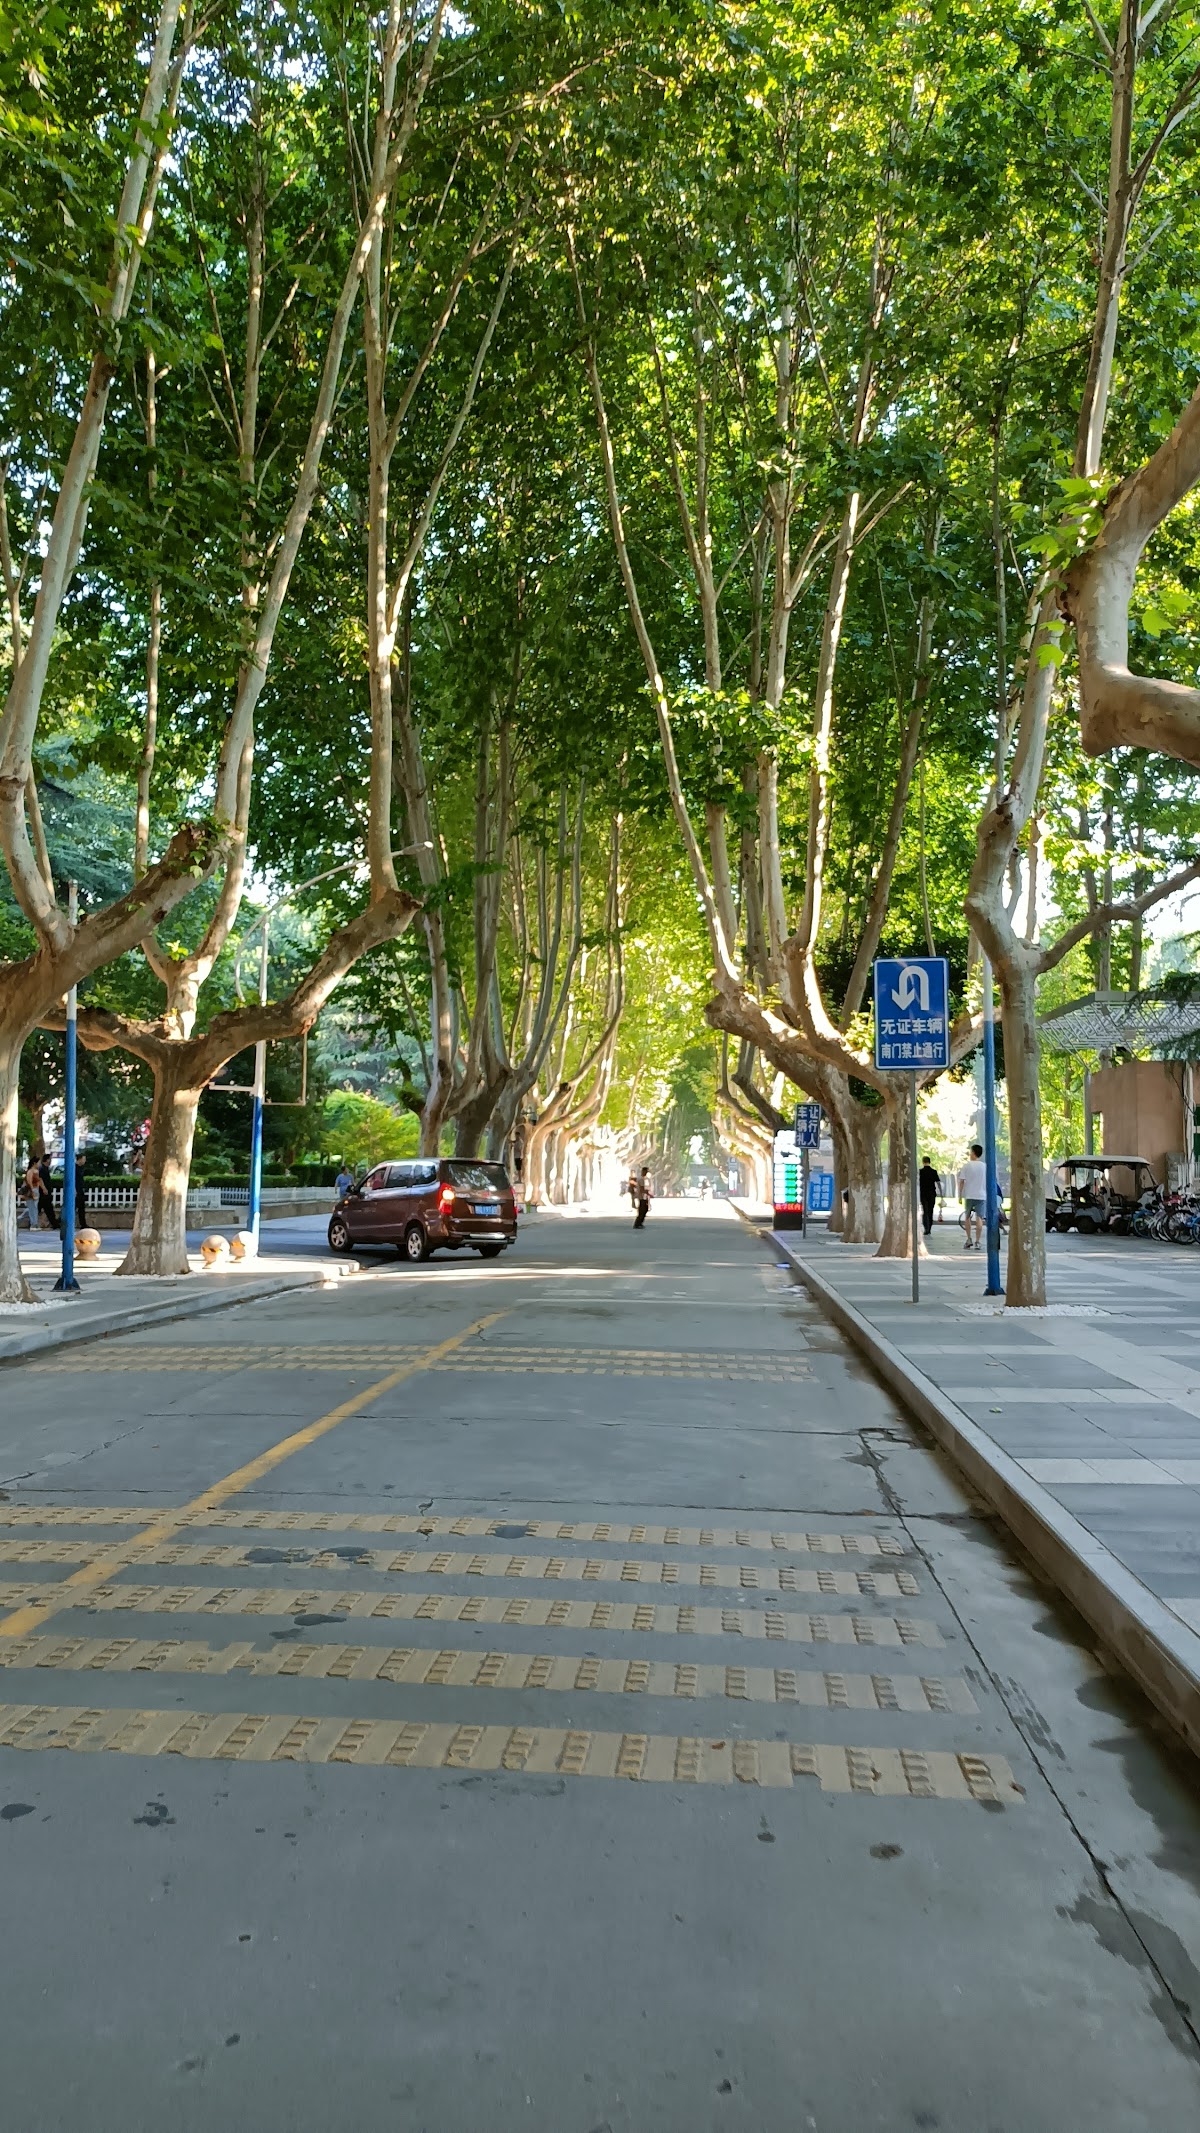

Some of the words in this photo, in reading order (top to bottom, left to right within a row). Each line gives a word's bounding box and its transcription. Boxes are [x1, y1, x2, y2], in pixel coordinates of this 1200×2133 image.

[881, 1018, 943, 1035] 无证车辆
[881, 1042, 944, 1059] 南门禁止通行
[796, 1105, 808, 1146] 车辆礼
[807, 1106, 819, 1146] 让行人
